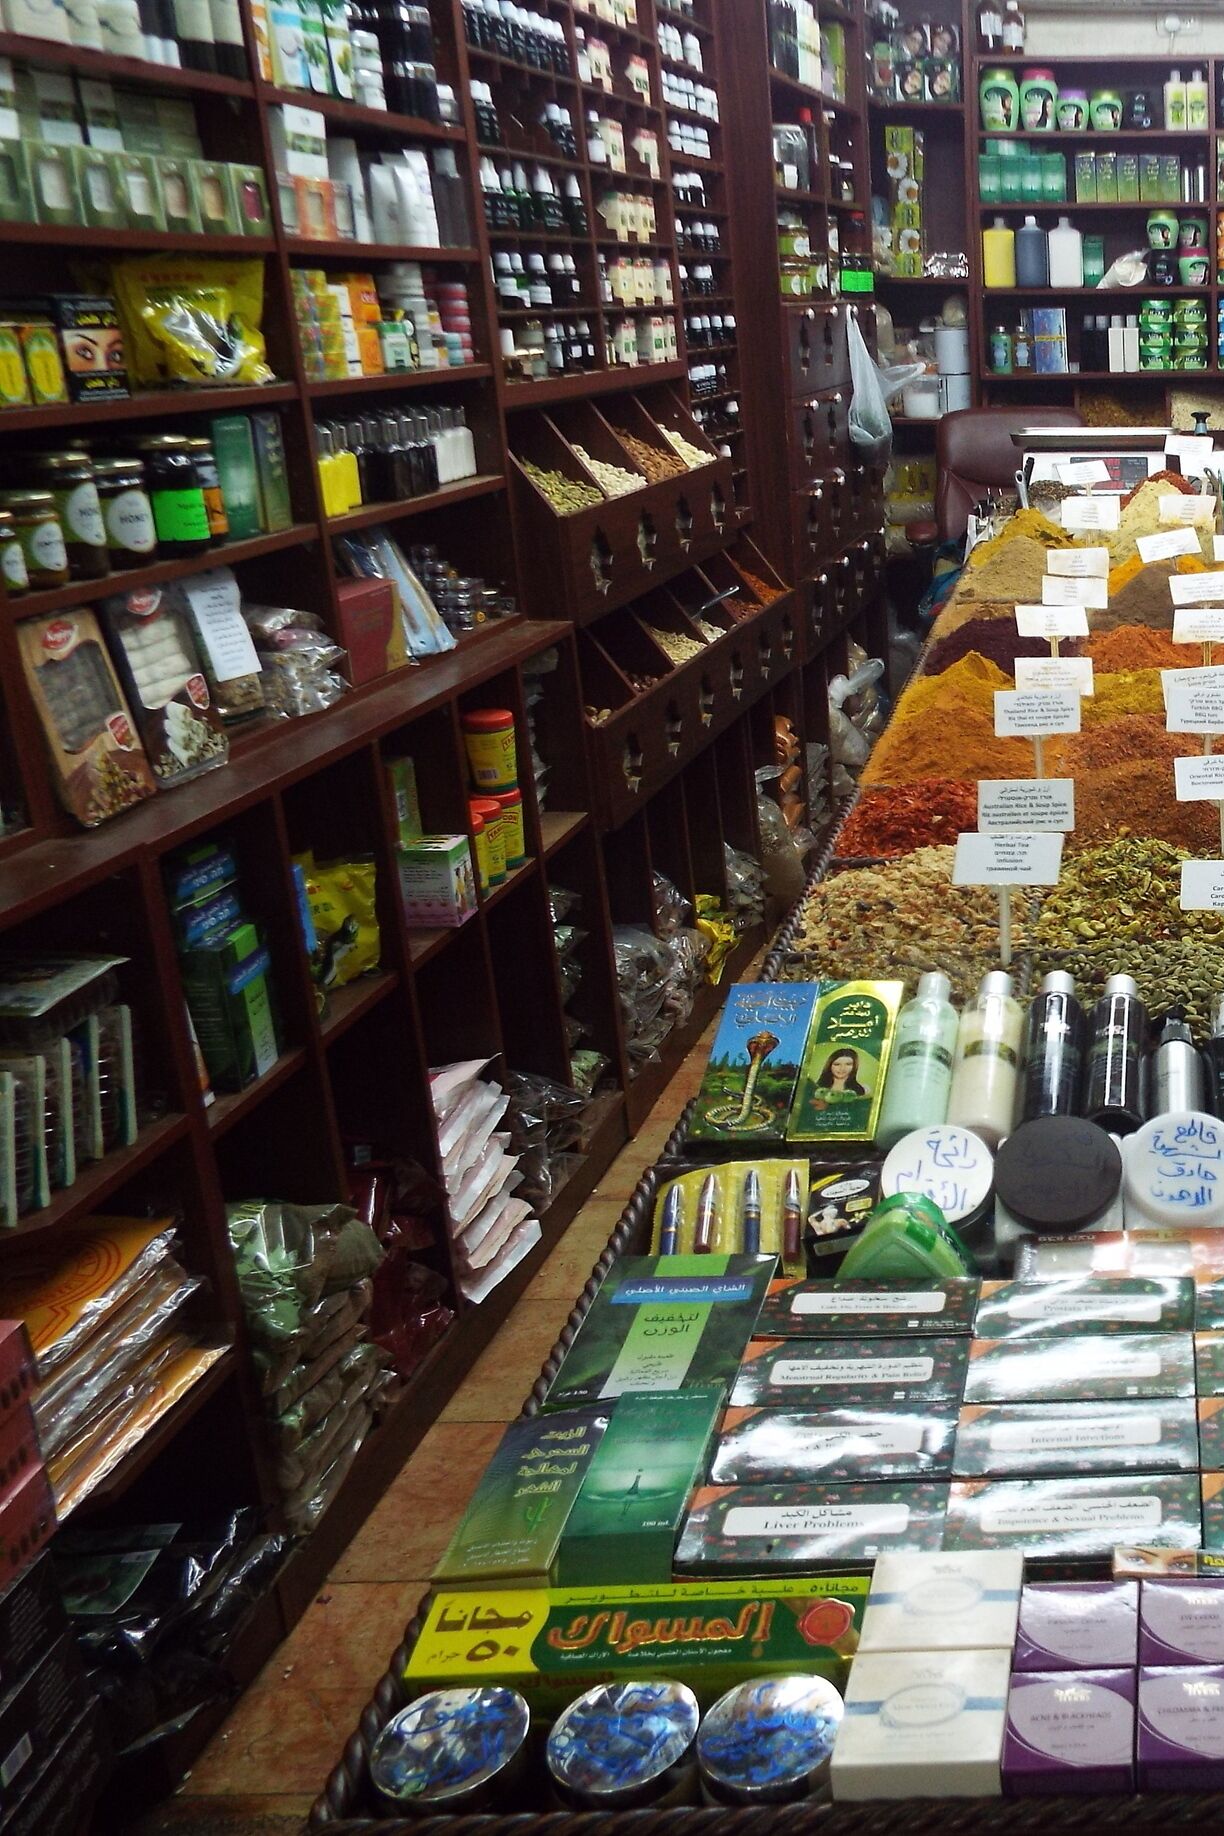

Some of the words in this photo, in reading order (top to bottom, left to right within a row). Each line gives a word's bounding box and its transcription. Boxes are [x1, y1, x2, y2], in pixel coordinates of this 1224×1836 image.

[983, 802, 1014, 810] Australian
[1035, 801, 1051, 809] Soup
[1051, 800, 1068, 808] Spice
[624, 1285, 665, 1298] الأصلي
[669, 1284, 709, 1297] الصيني
[712, 1282, 746, 1295] الشاي
[643, 1311, 700, 1325] لتخفيف
[642, 1323, 690, 1338] الوزن
[825, 1373, 869, 1383] Regularity
[1030, 1436, 1074, 1444] Internal
[1074, 1432, 1126, 1443] Infections
[780, 1509, 810, 1518] الكبد
[811, 1509, 853, 1519] مشاكل
[1063, 1514, 1097, 1523] Sexual
[763, 1519, 799, 1530] Liver
[803, 1517, 866, 1530] Problems
[434, 1602, 534, 1634] مجاناً
[546, 1600, 776, 1648] المسواك
[466, 1639, 520, 1663] ٥٠
